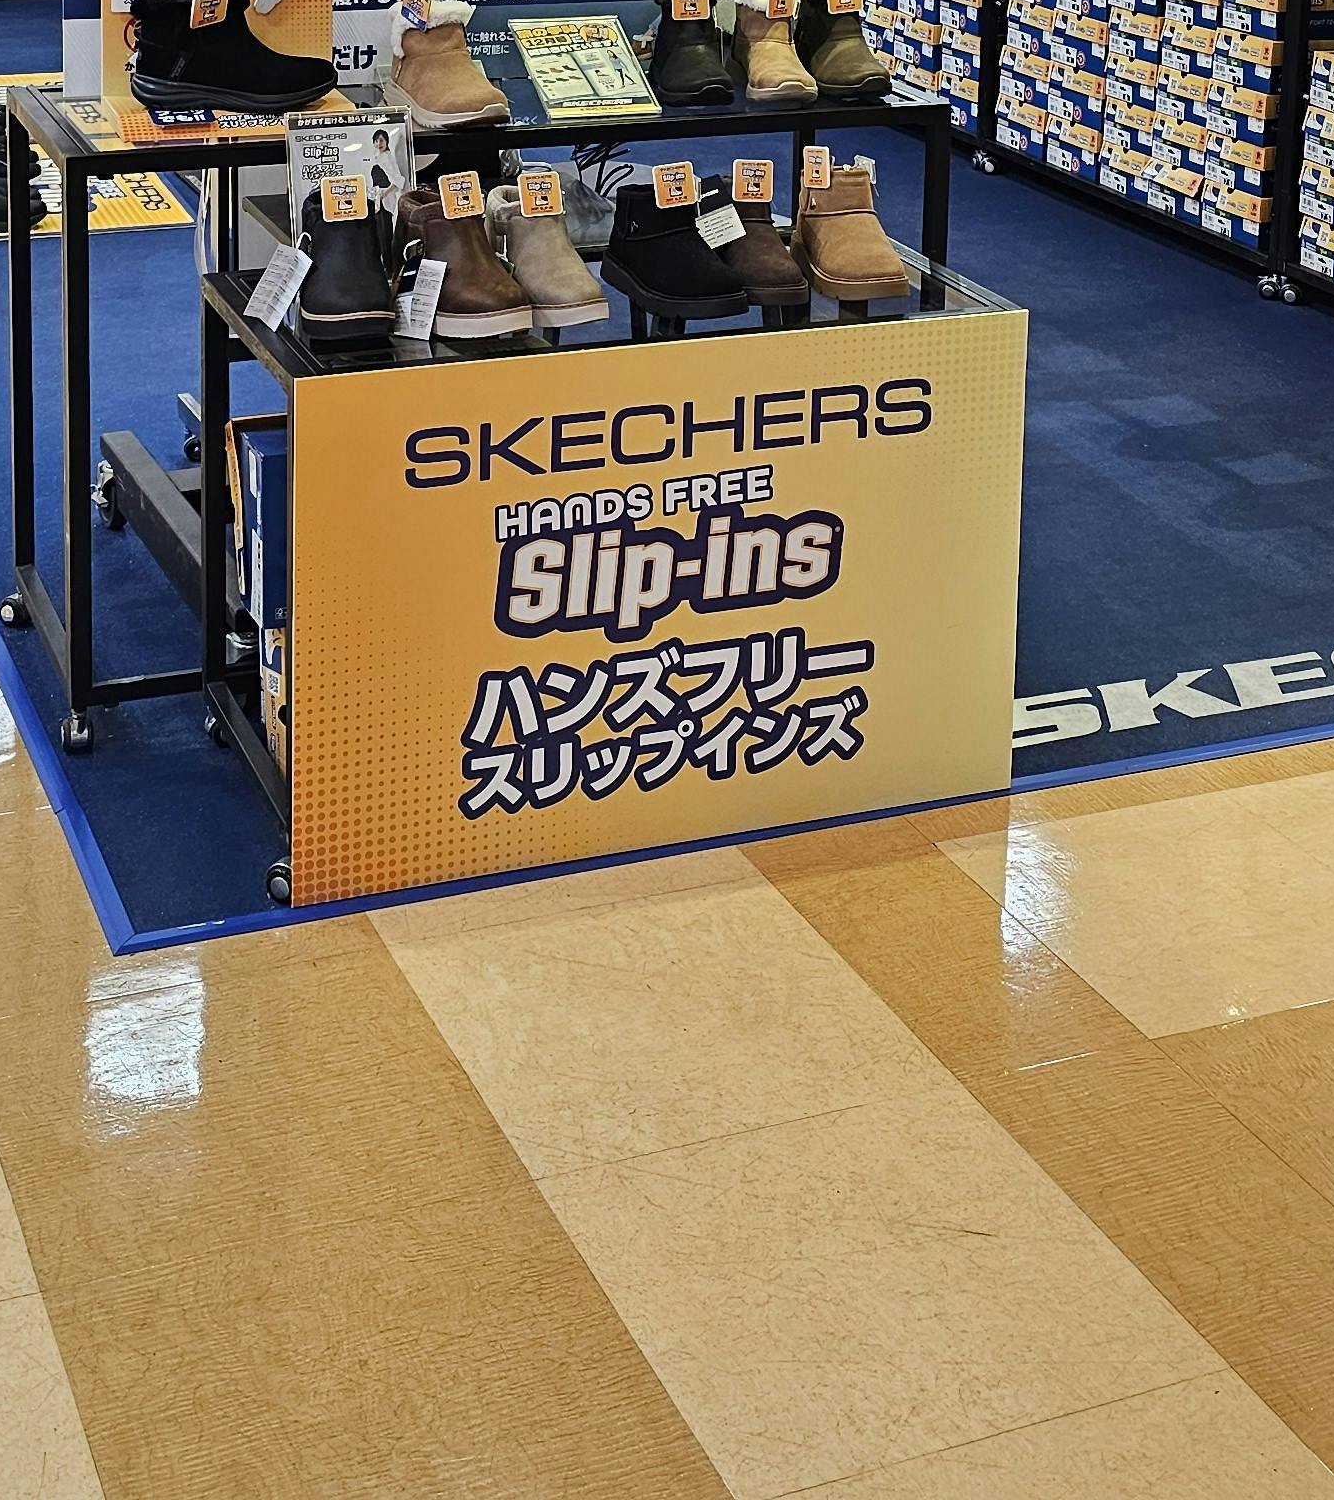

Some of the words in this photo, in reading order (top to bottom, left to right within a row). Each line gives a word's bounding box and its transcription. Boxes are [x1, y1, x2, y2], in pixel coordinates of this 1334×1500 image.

[333, 45, 377, 70] だけ
[295, 133, 347, 142] SKECHERS
[303, 147, 339, 158] Slip-ins
[403, 377, 933, 489] SKECHERS
[497, 485, 651, 541] HANDS
[665, 466, 772, 513] FREE
[501, 514, 837, 634] Slip-ins
[468, 634, 870, 747] ハンズフリー
[464, 695, 862, 812] スリップインズ
